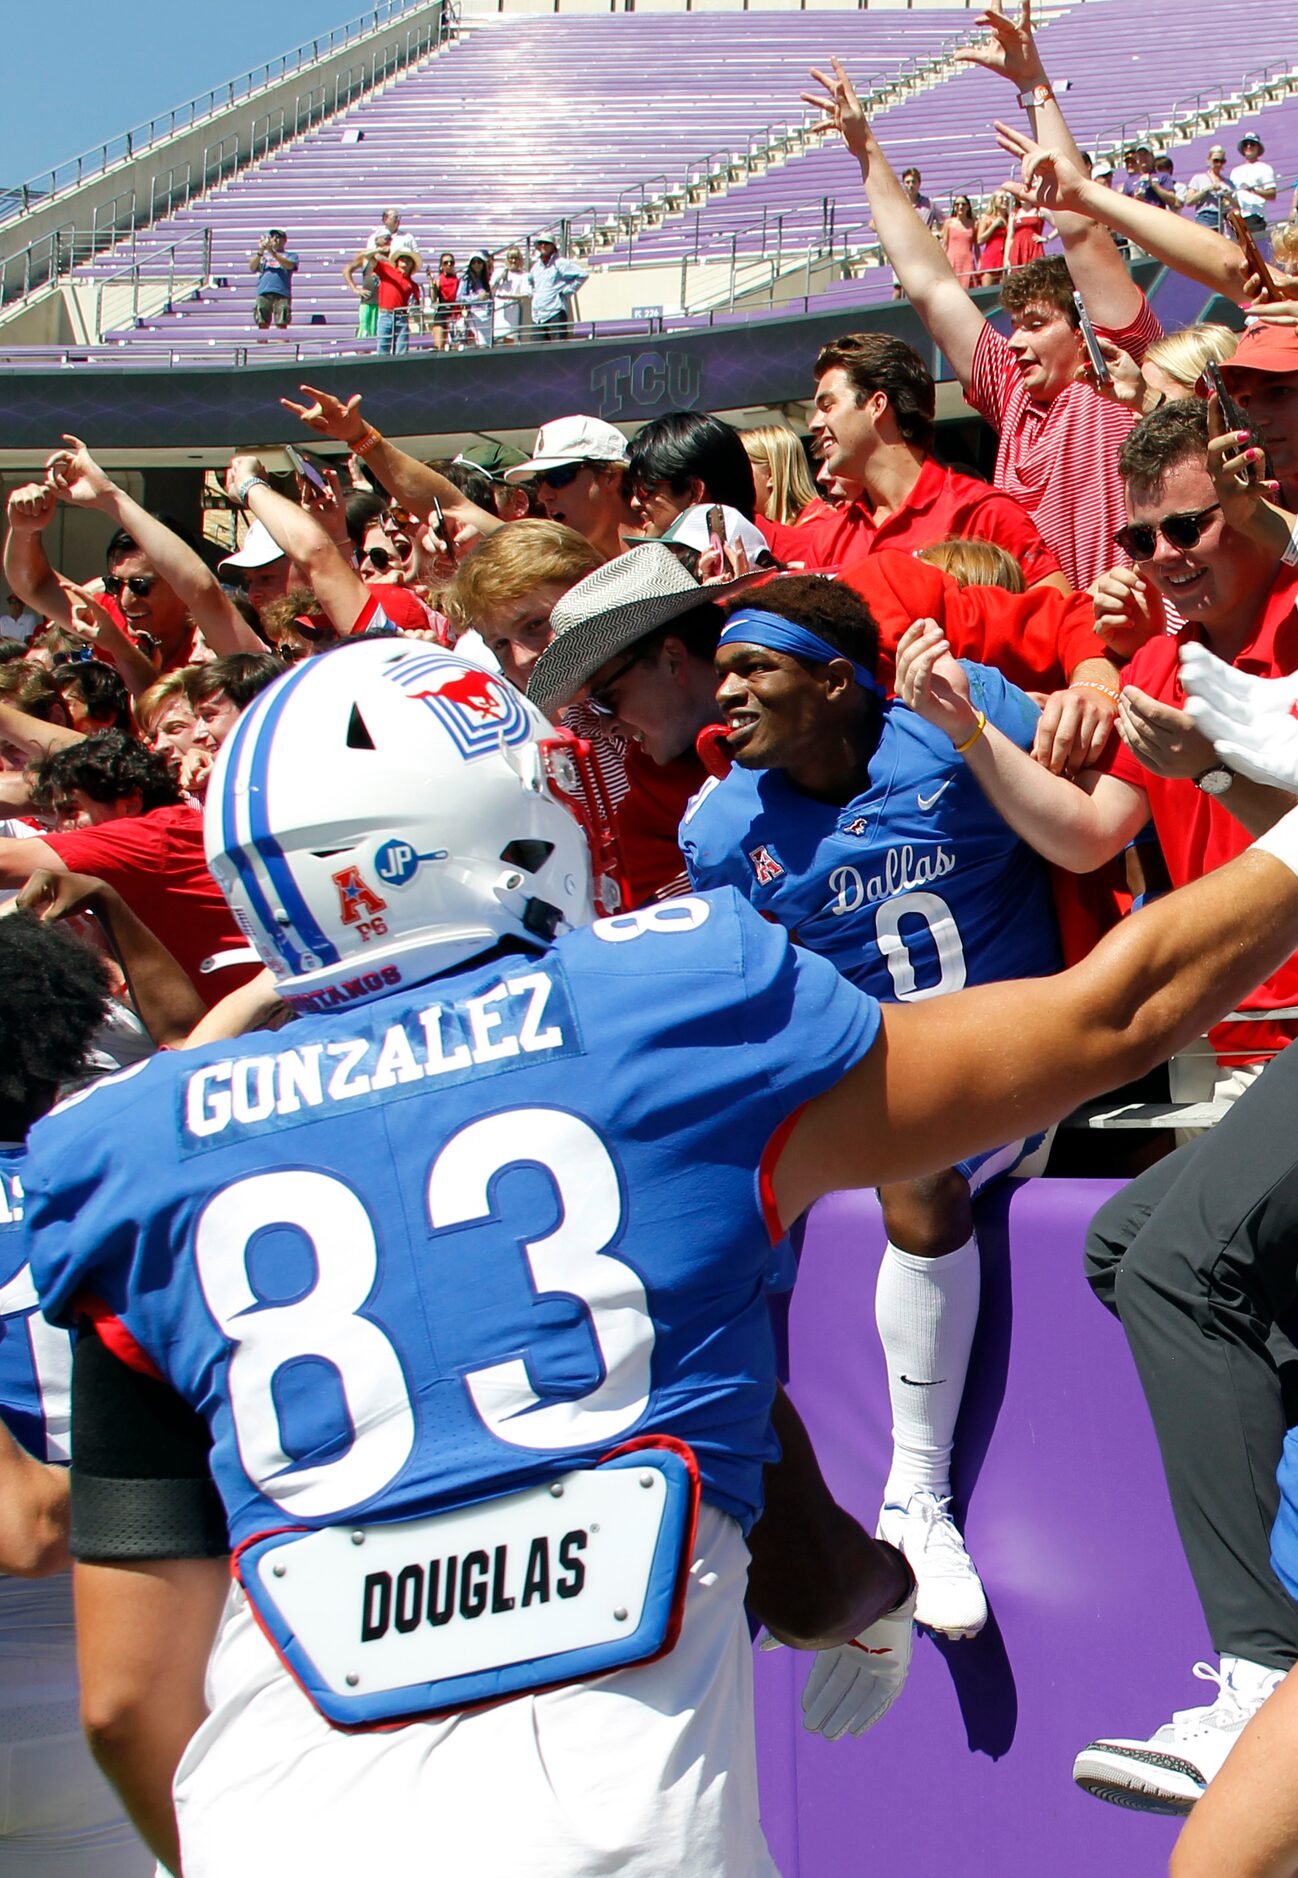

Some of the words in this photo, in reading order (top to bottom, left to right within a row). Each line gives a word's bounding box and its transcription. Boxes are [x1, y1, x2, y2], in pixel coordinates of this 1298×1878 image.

[591, 352, 704, 418] TCU
[331, 865, 388, 925] A
[380, 845, 412, 878] JP
[749, 845, 786, 886] A
[828, 845, 956, 916] Dallas
[875, 891, 967, 1003] 0
[186, 972, 563, 1137] GONZALEZ
[194, 1108, 656, 1518] 83
[361, 1529, 587, 1642] DOUGLAS
